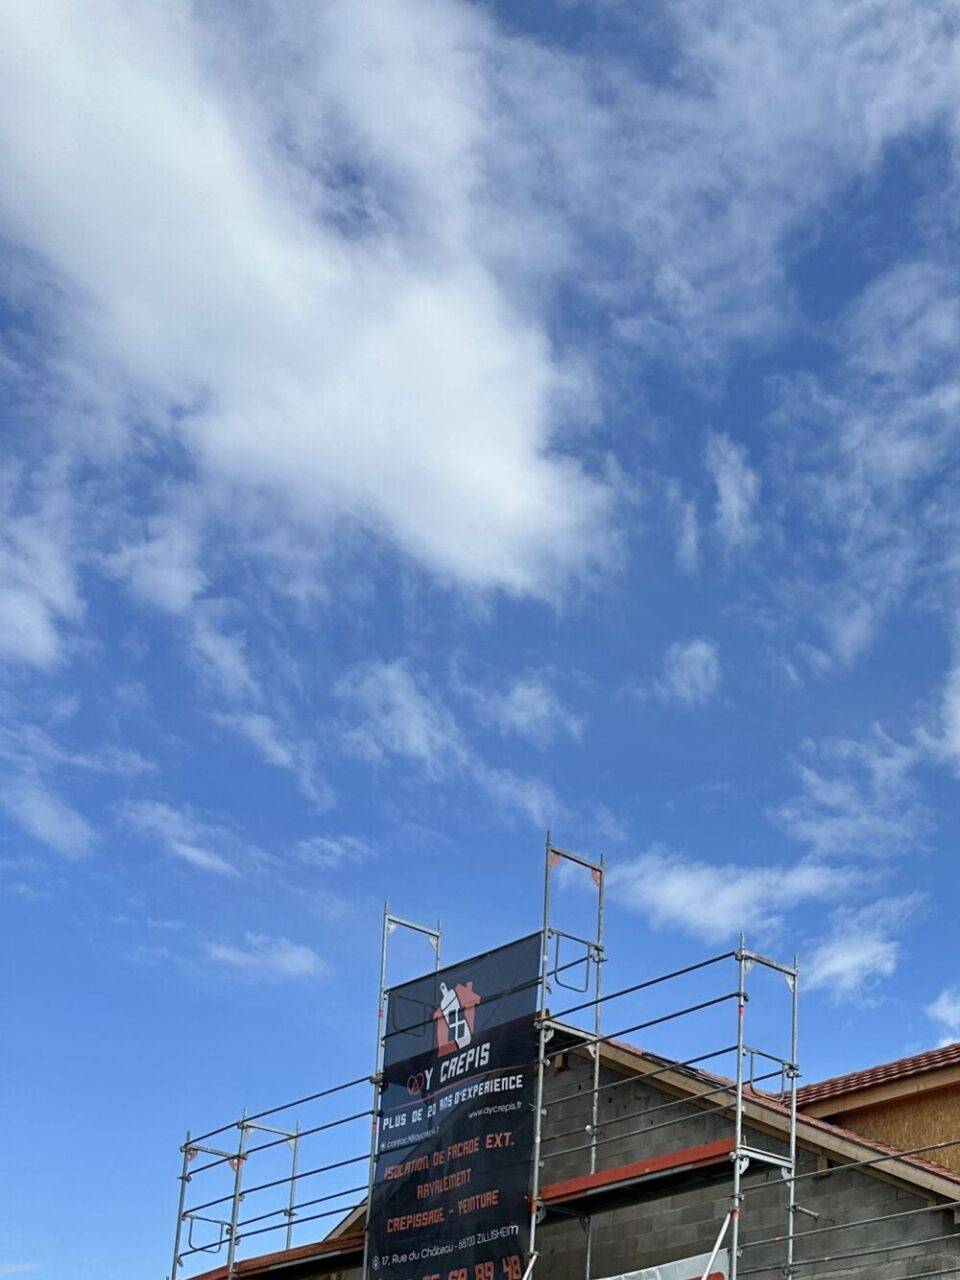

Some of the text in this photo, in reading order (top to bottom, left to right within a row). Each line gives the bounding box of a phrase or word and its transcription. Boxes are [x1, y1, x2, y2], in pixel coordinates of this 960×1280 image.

[440, 1042, 490, 1083] CREPIS
[383, 1115, 406, 1131] PLUS
[412, 1108, 423, 1123] DE
[427, 1104, 436, 1117] 20
[384, 1132, 515, 1180] ISOLATION DE FACADE EXT.
[417, 1168, 472, 1200] RAVALEMENT
[387, 1207, 445, 1233] CREPISSAGE
[458, 1190, 499, 1216] PEINTURE
[392, 1253, 407, 1264] Rue
[408, 1250, 420, 1261] du
